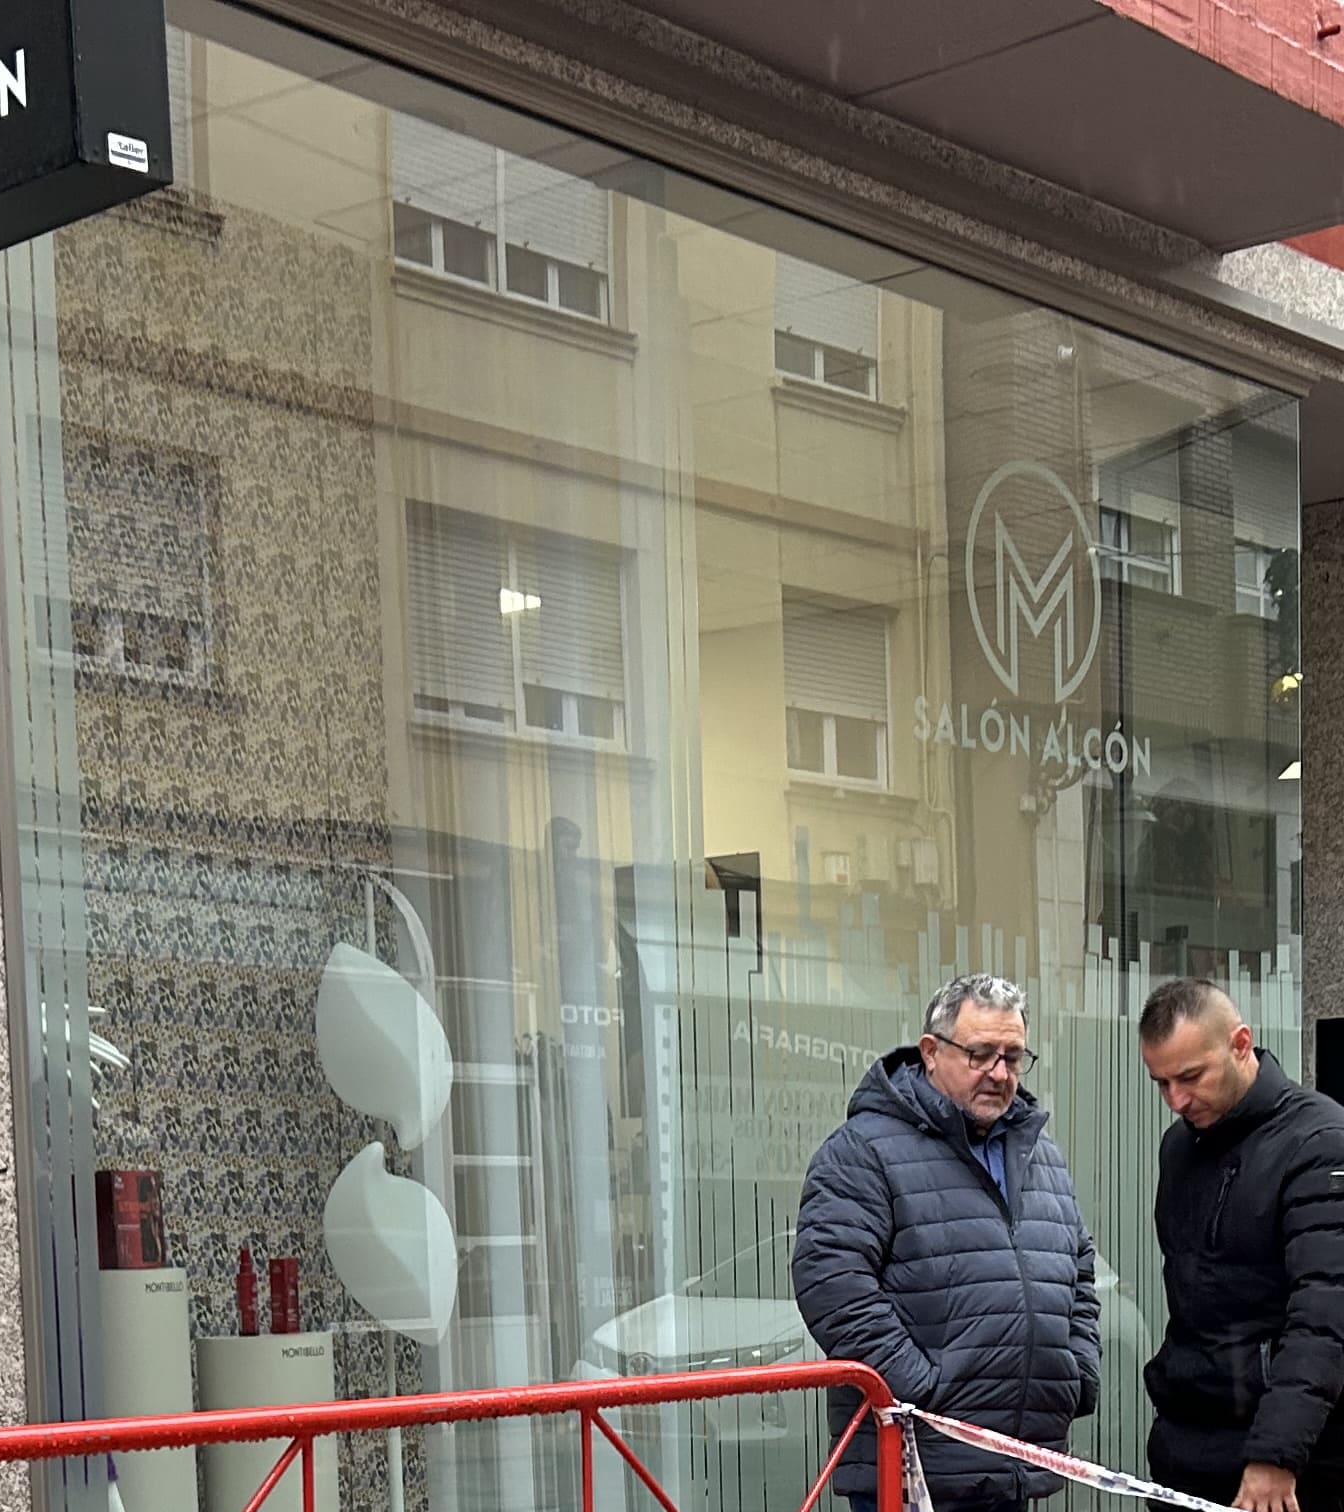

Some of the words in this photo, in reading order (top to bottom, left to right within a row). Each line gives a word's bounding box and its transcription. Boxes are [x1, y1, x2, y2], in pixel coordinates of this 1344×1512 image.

[913, 695, 1031, 759] SALÓN
[1040, 720, 1152, 777] ALCÓN
[145, 1282, 184, 1293] MONTIBELLO
[281, 1346, 325, 1358] MONTIBELLO
